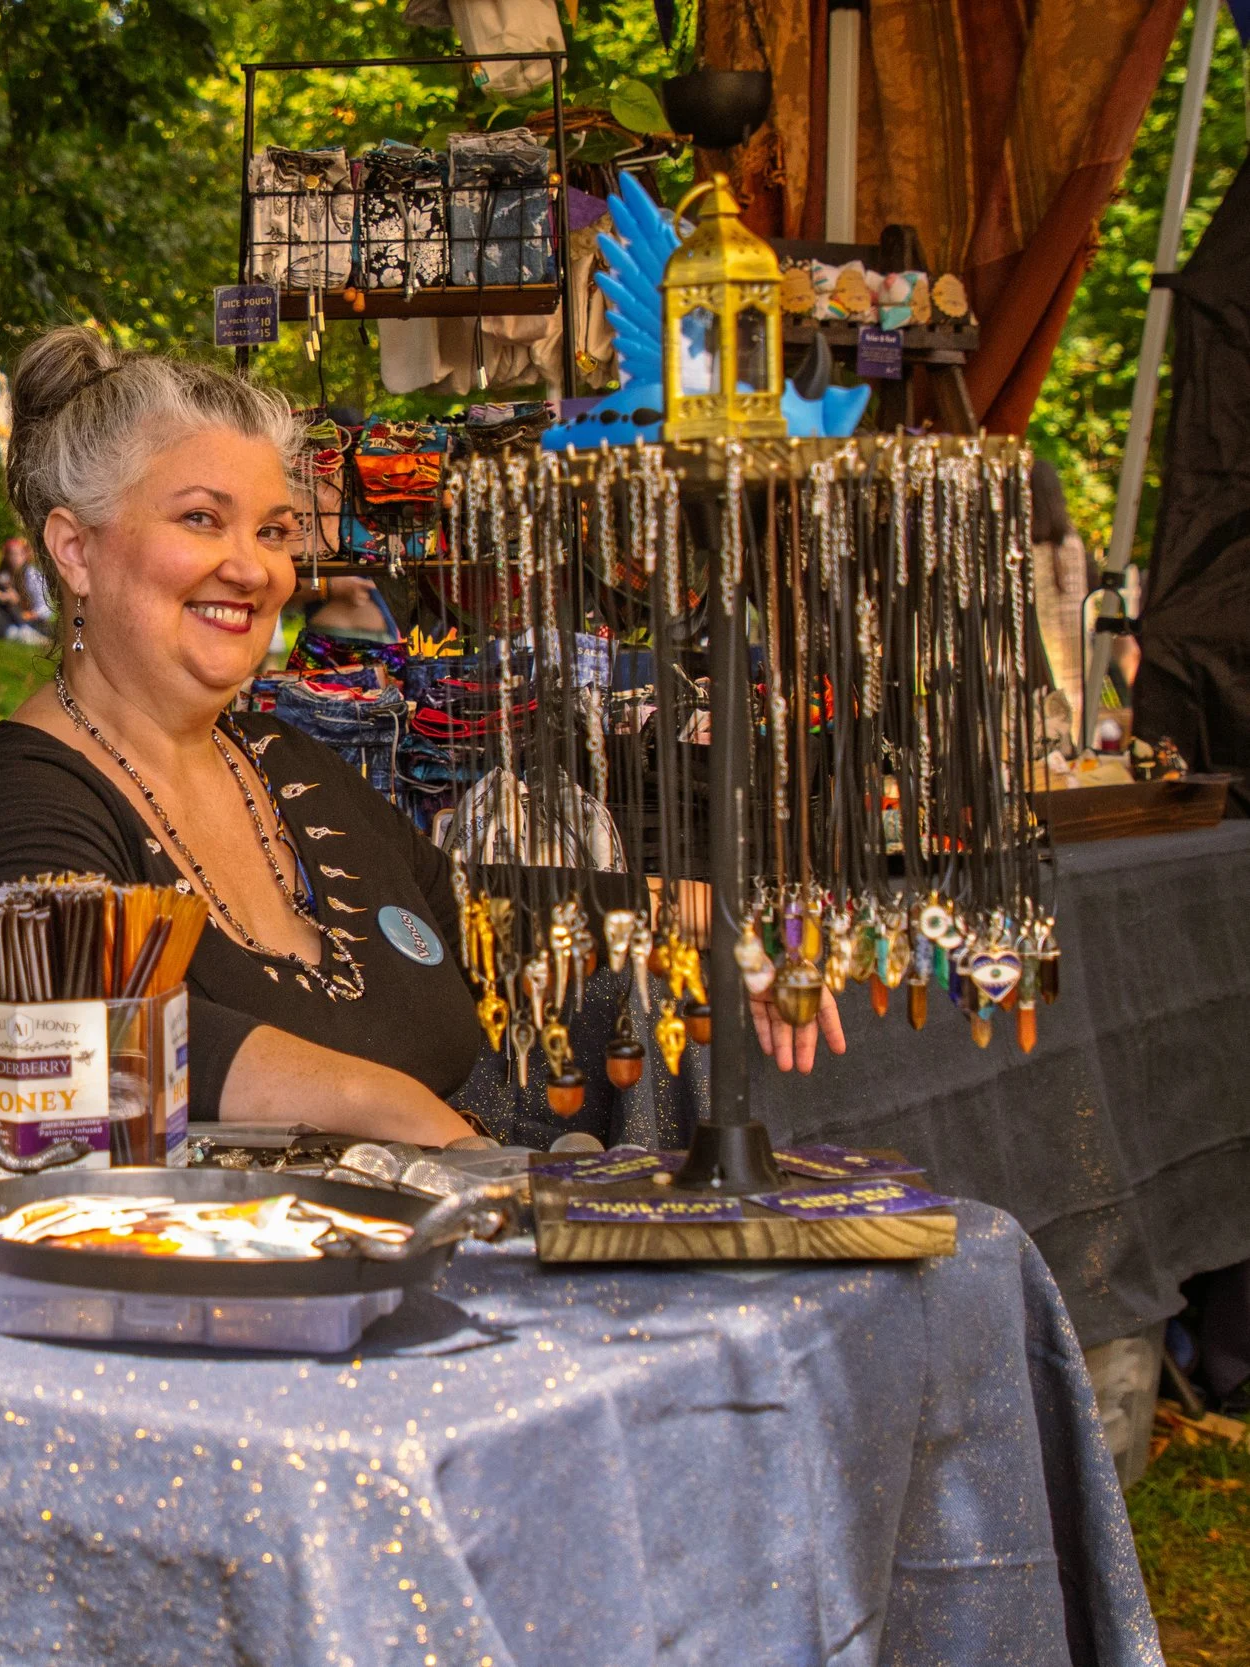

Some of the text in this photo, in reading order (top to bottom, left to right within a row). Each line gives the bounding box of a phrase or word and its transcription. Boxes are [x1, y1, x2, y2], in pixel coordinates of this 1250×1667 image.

[244, 296, 272, 306] POUCH
[396, 907, 432, 959] Vendor
[36, 1019, 81, 1034] HONEY
[75, 1126, 103, 1134] Infused
